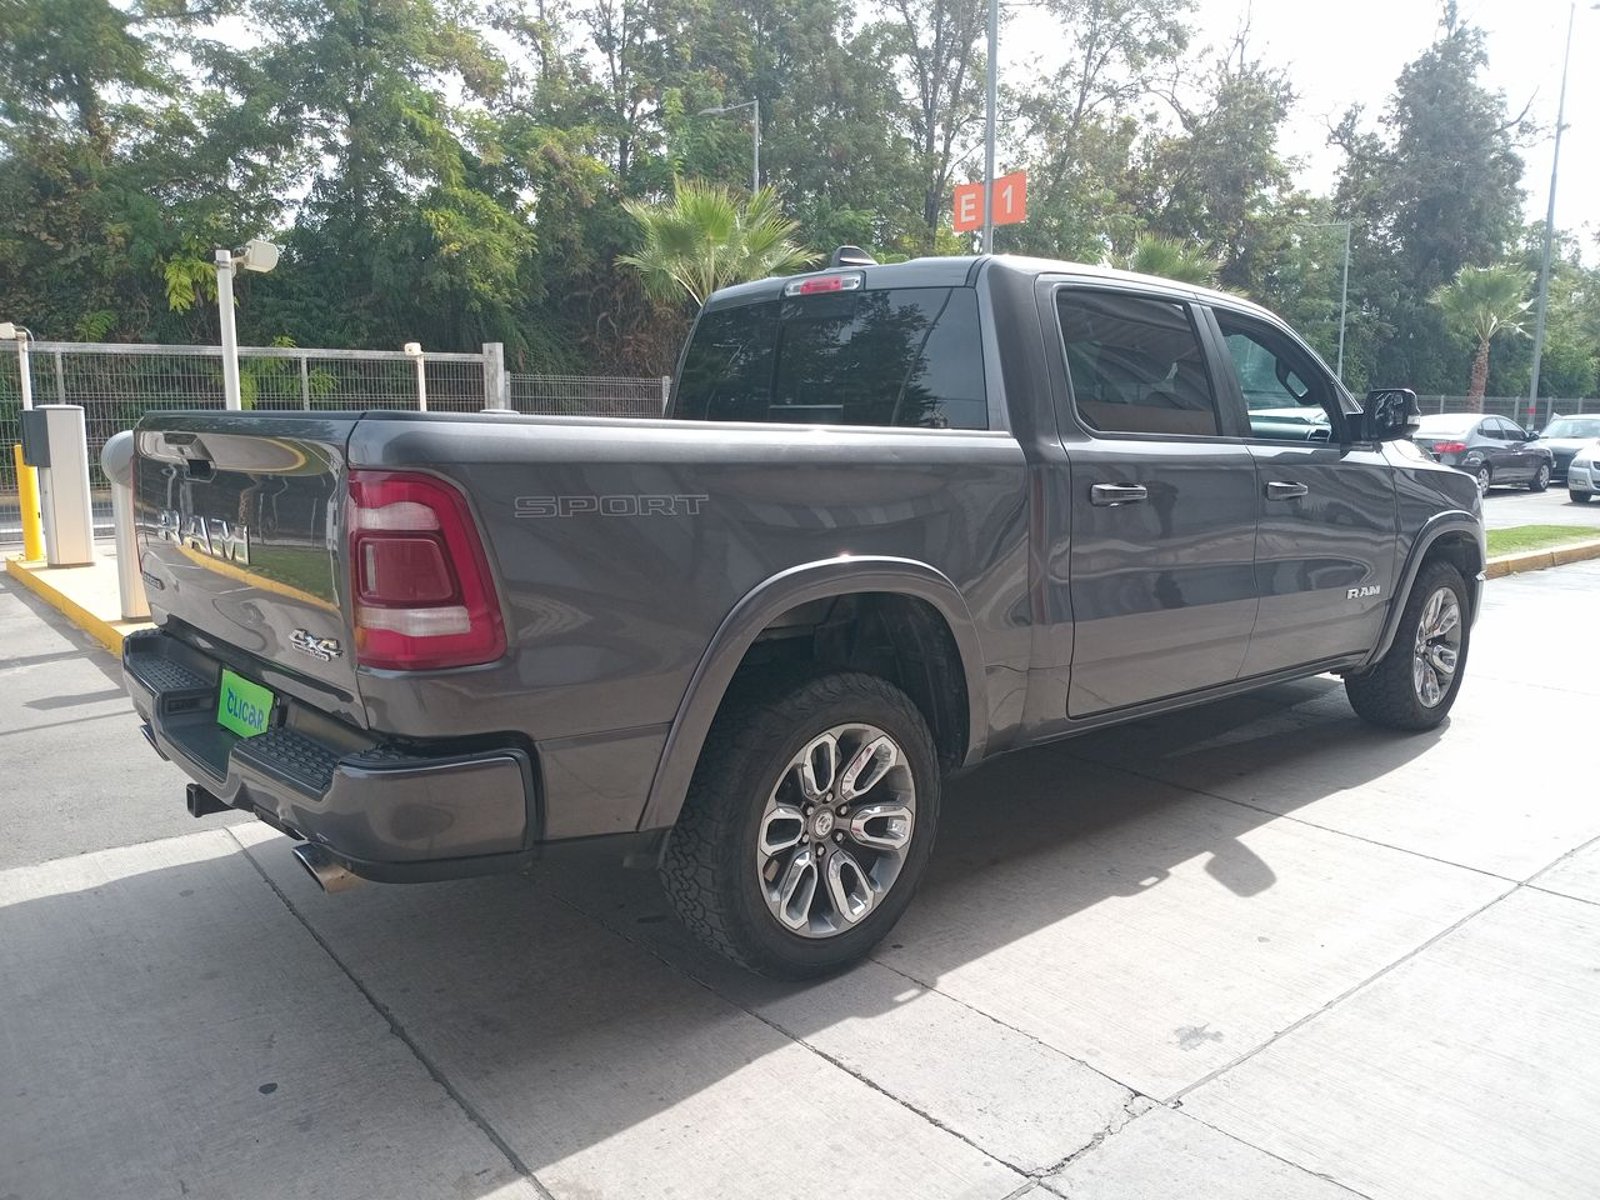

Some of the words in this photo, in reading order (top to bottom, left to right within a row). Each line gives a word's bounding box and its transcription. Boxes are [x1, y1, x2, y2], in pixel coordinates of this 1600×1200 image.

[960, 193, 976, 223] E
[1002, 184, 1013, 214] 1
[514, 494, 709, 518] SPORT
[158, 509, 250, 565] RAM
[1346, 585, 1381, 600] RAM
